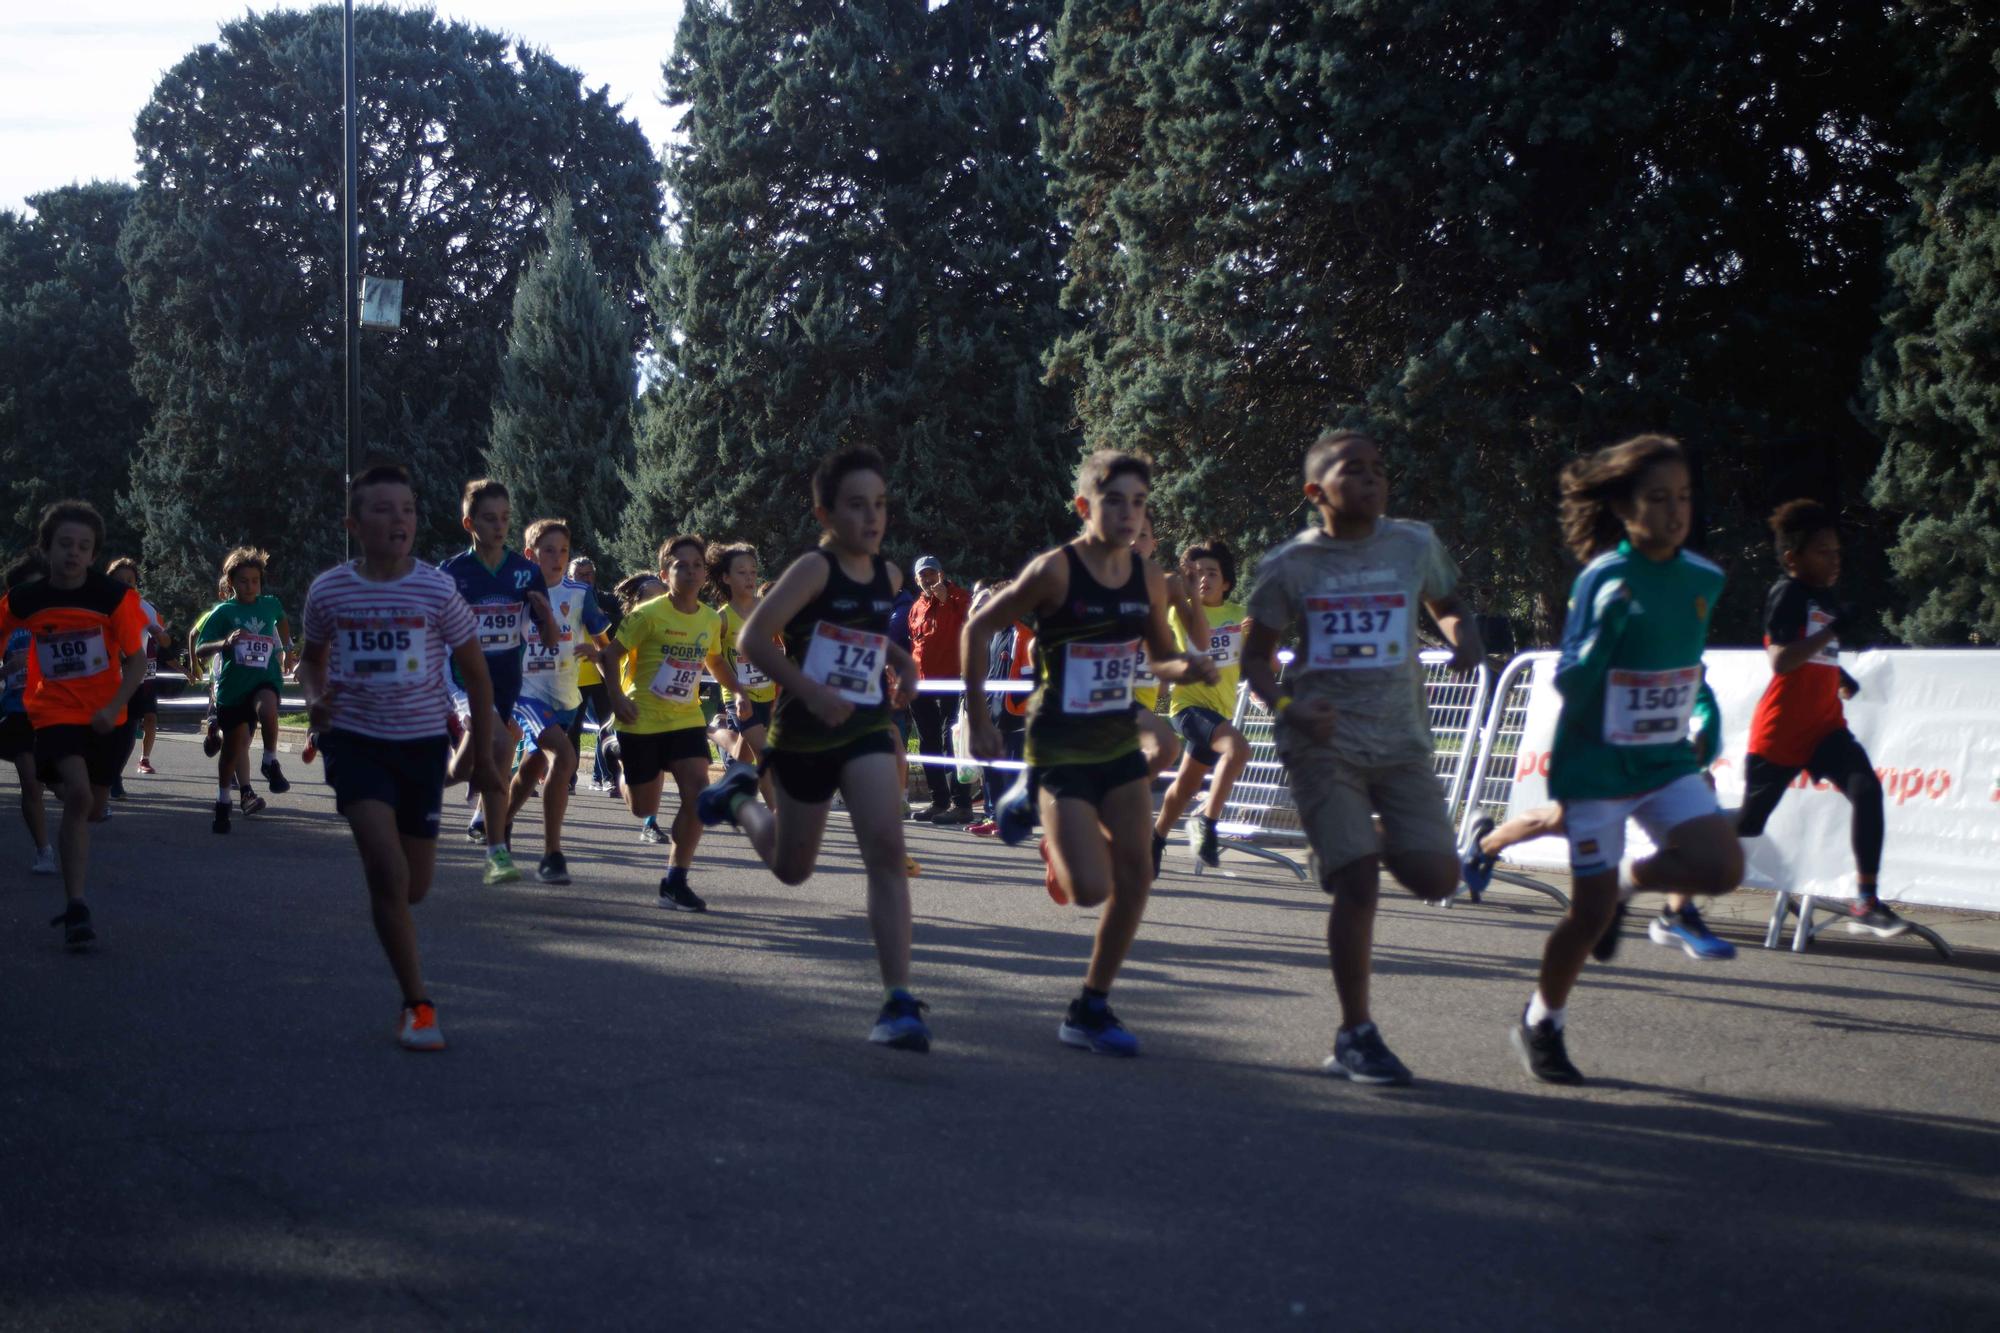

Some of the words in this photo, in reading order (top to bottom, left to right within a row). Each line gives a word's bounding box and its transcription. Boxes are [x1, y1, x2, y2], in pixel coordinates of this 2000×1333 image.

[514, 570, 532, 589] 22
[1322, 610, 1390, 634] 2137
[51, 641, 87, 658] 160
[246, 641, 268, 653] 169
[348, 631, 411, 651] 1505
[529, 643, 559, 656] 176
[1211, 635, 1230, 648] 88
[834, 645, 876, 671] 174
[1093, 659, 1131, 680] 185
